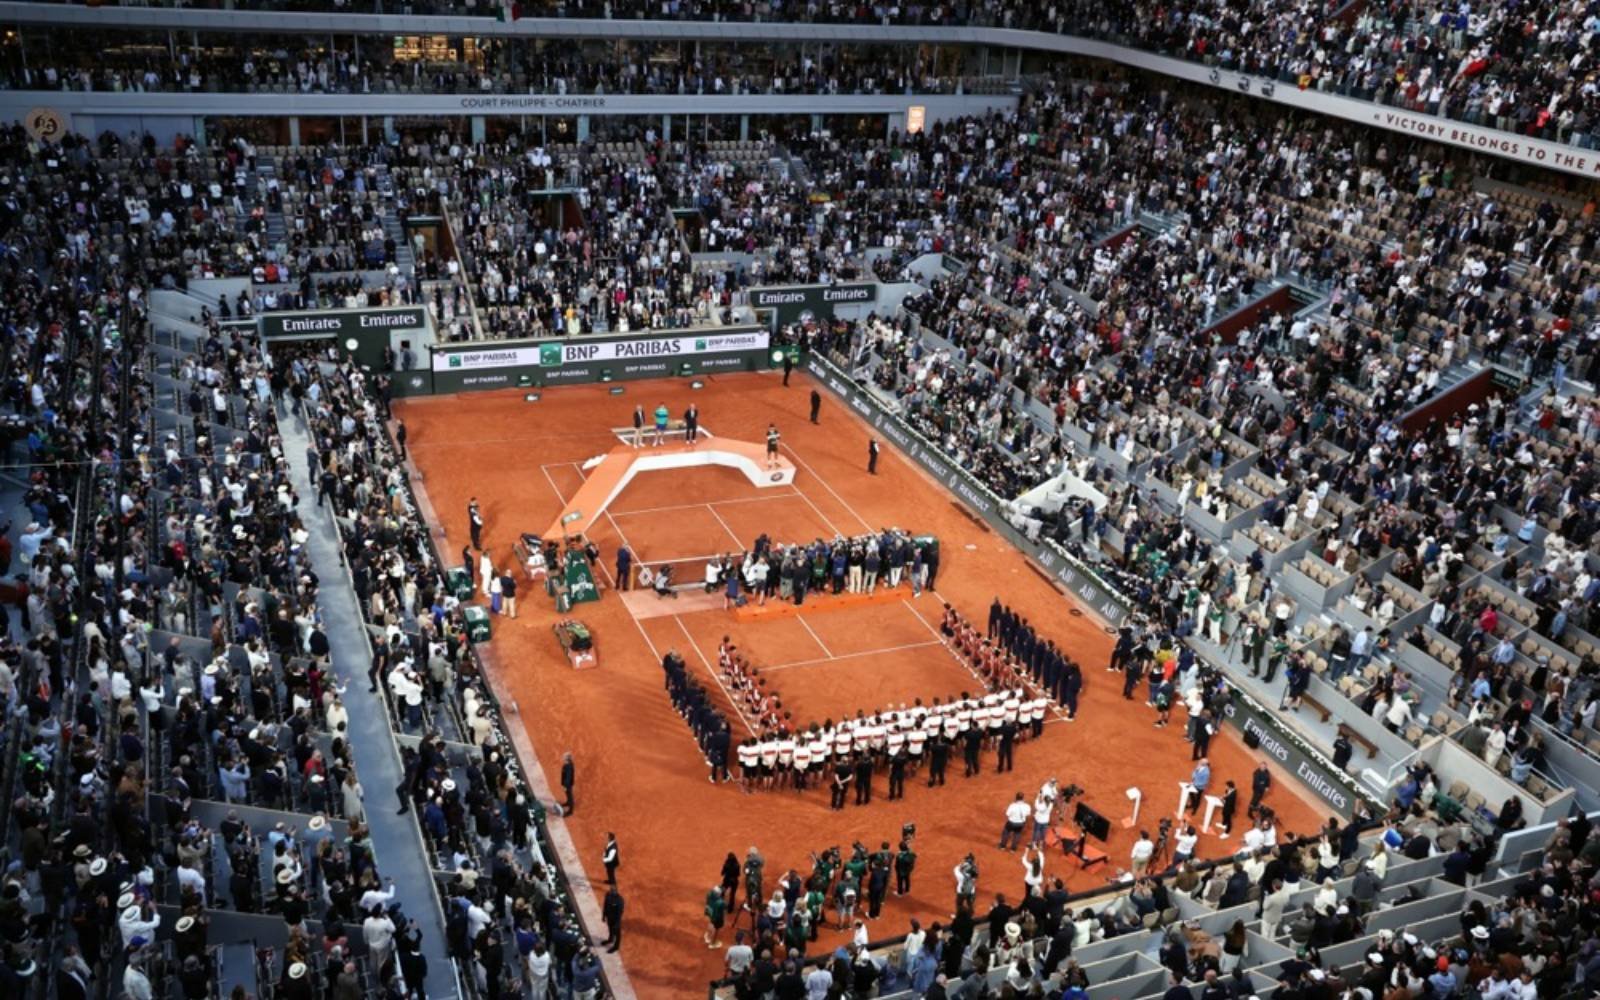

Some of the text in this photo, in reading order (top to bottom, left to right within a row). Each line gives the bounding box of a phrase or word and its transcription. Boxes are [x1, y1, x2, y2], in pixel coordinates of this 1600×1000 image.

[460, 97, 498, 108] COURT
[500, 97, 547, 108] PHILIPPE
[555, 97, 606, 108] CHATRIER
[1386, 113, 1446, 137] VICTORY
[1451, 130, 1519, 154] BELONGS
[1527, 146, 1547, 160] TO
[1554, 152, 1586, 169] THE
[760, 292, 806, 304] Emirates
[823, 288, 869, 300] Emirates
[282, 317, 342, 332] Emirates
[360, 313, 417, 327] Emirates
[566, 339, 681, 361] BNP PARIBAS
[960, 483, 990, 511] RENAULT
[1297, 761, 1347, 809] Emirates
